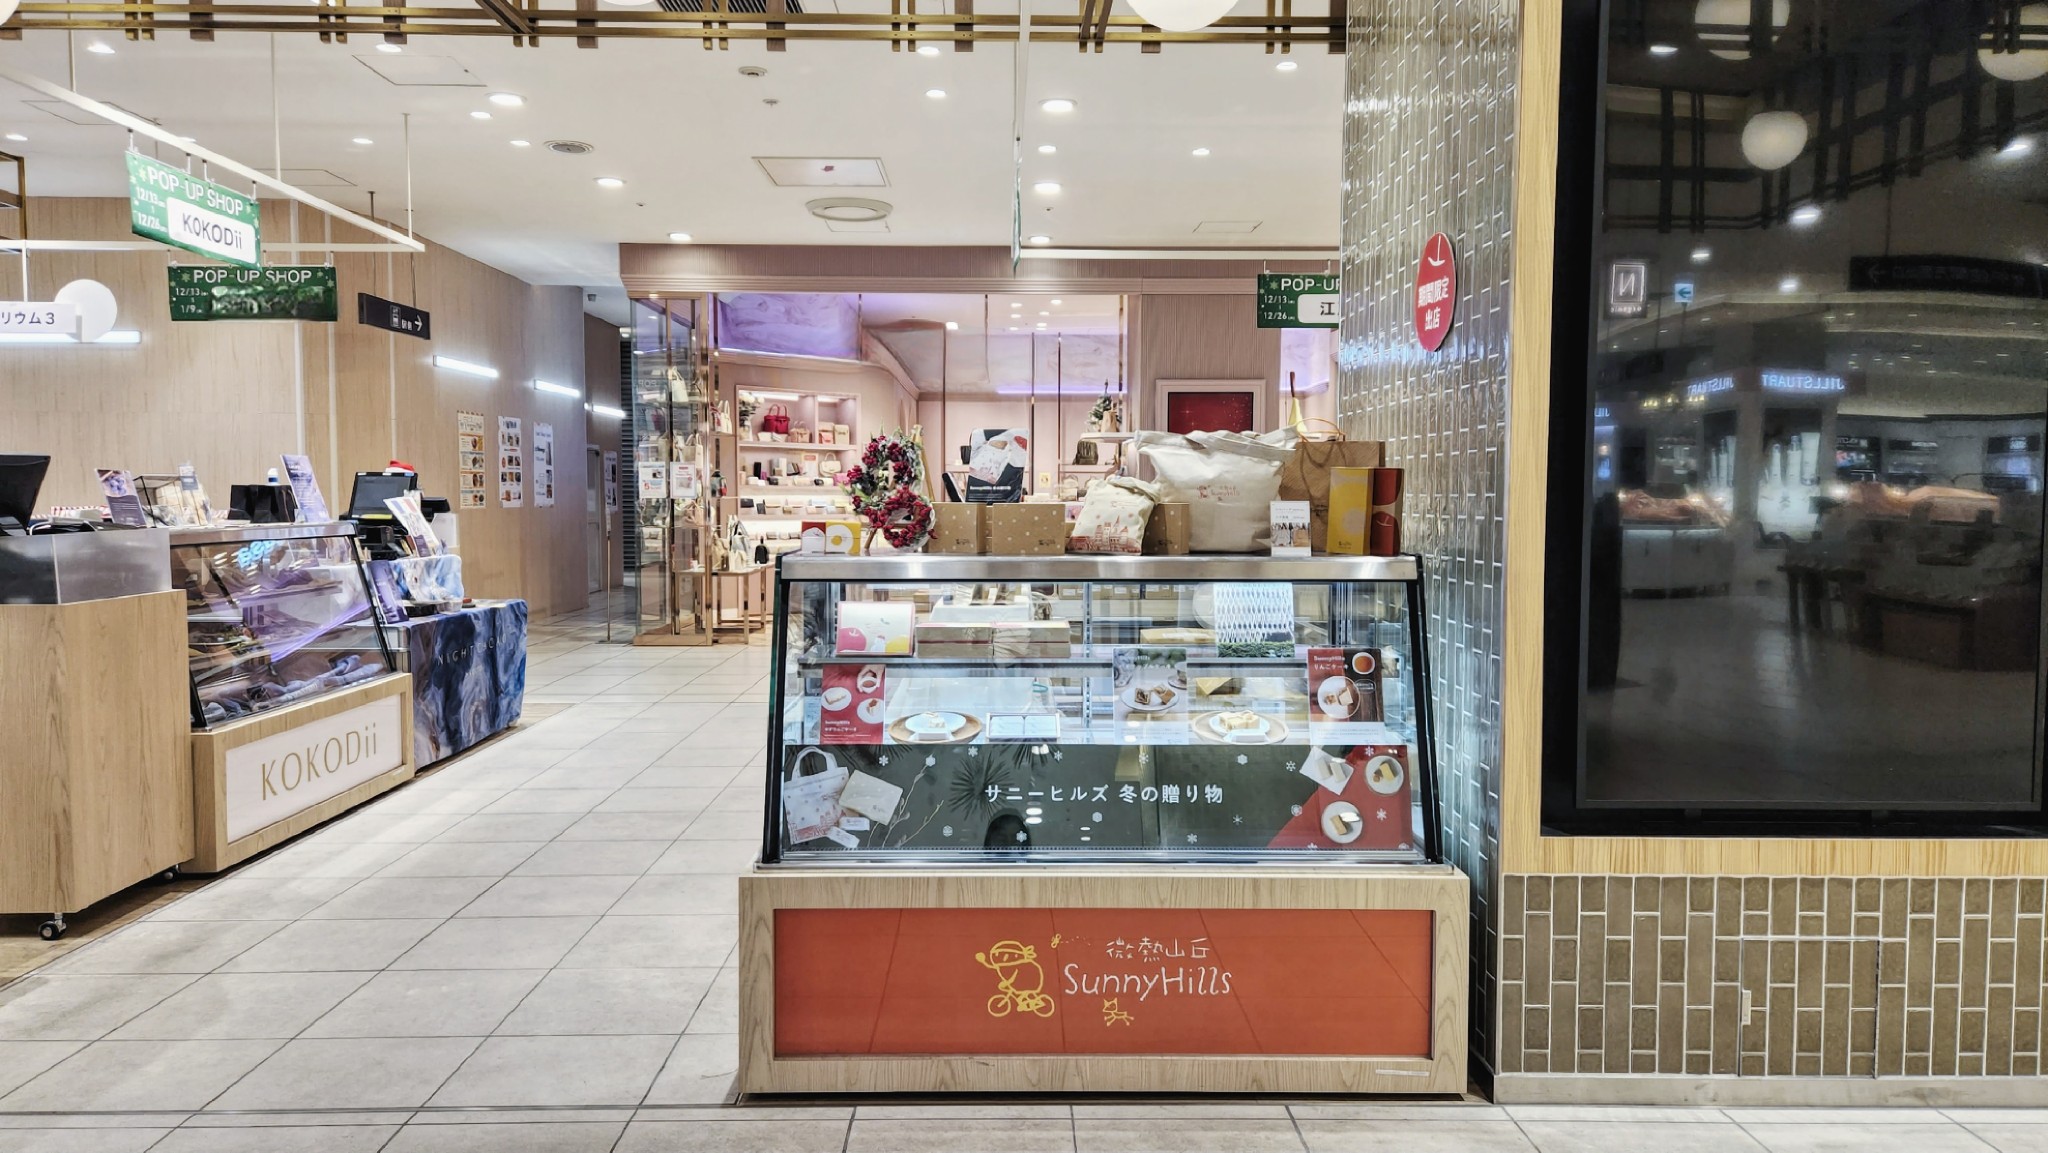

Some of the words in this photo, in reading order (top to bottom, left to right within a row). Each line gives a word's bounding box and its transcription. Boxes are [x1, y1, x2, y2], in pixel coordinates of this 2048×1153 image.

[147, 166, 204, 201] POP-UP
[207, 189, 243, 216] SHOP
[182, 212, 242, 249] KOKODii
[193, 269, 260, 283] POP-UP
[265, 269, 312, 283] SHOP
[1320, 302, 1340, 316] 江
[1424, 306, 1441, 331] 出店
[262, 722, 376, 800] KOKODii
[985, 785, 1109, 802] サニーヒルズ
[1118, 784, 1223, 804] 冬の贈り物
[1064, 962, 1232, 1002] SunnyHills
